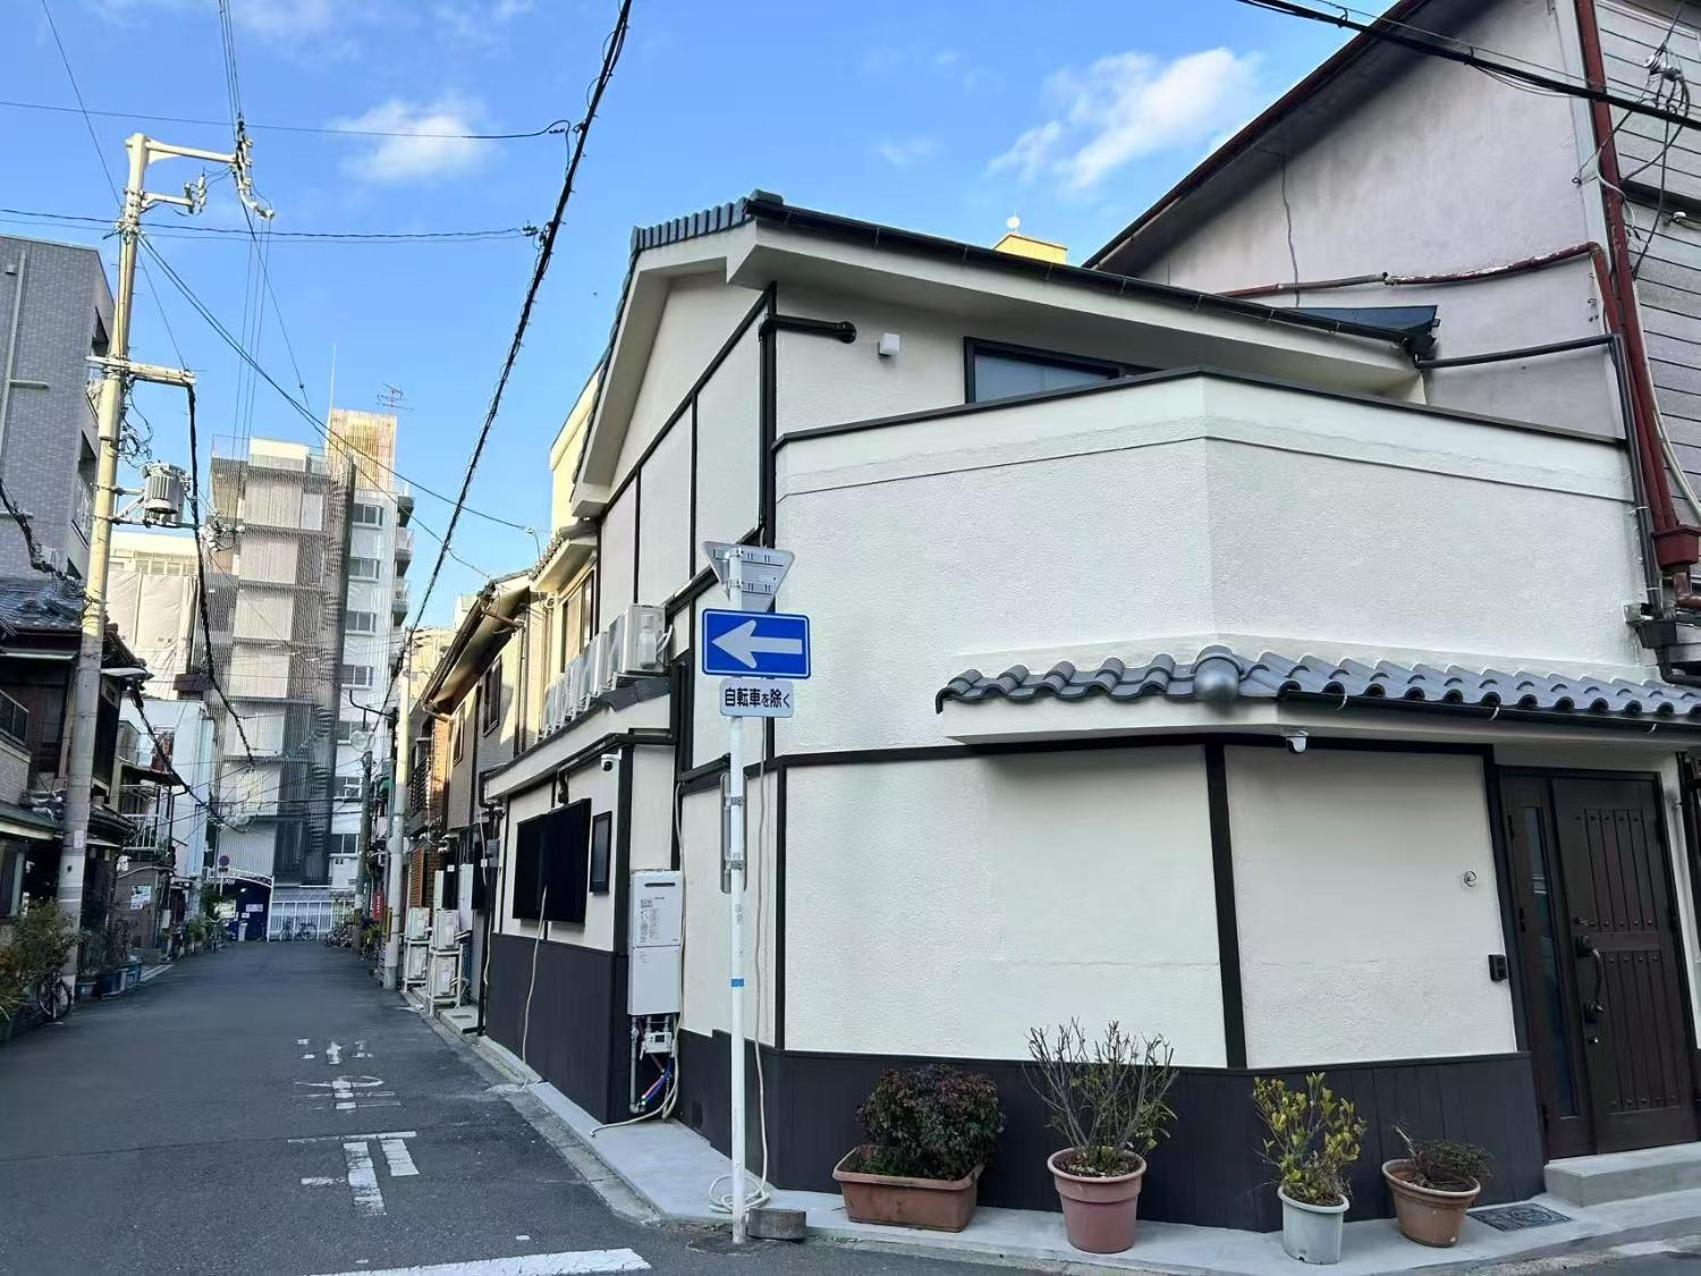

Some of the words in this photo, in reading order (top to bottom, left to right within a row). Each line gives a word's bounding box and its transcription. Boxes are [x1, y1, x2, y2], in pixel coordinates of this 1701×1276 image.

[725, 687, 790, 708] 自転車を除く
